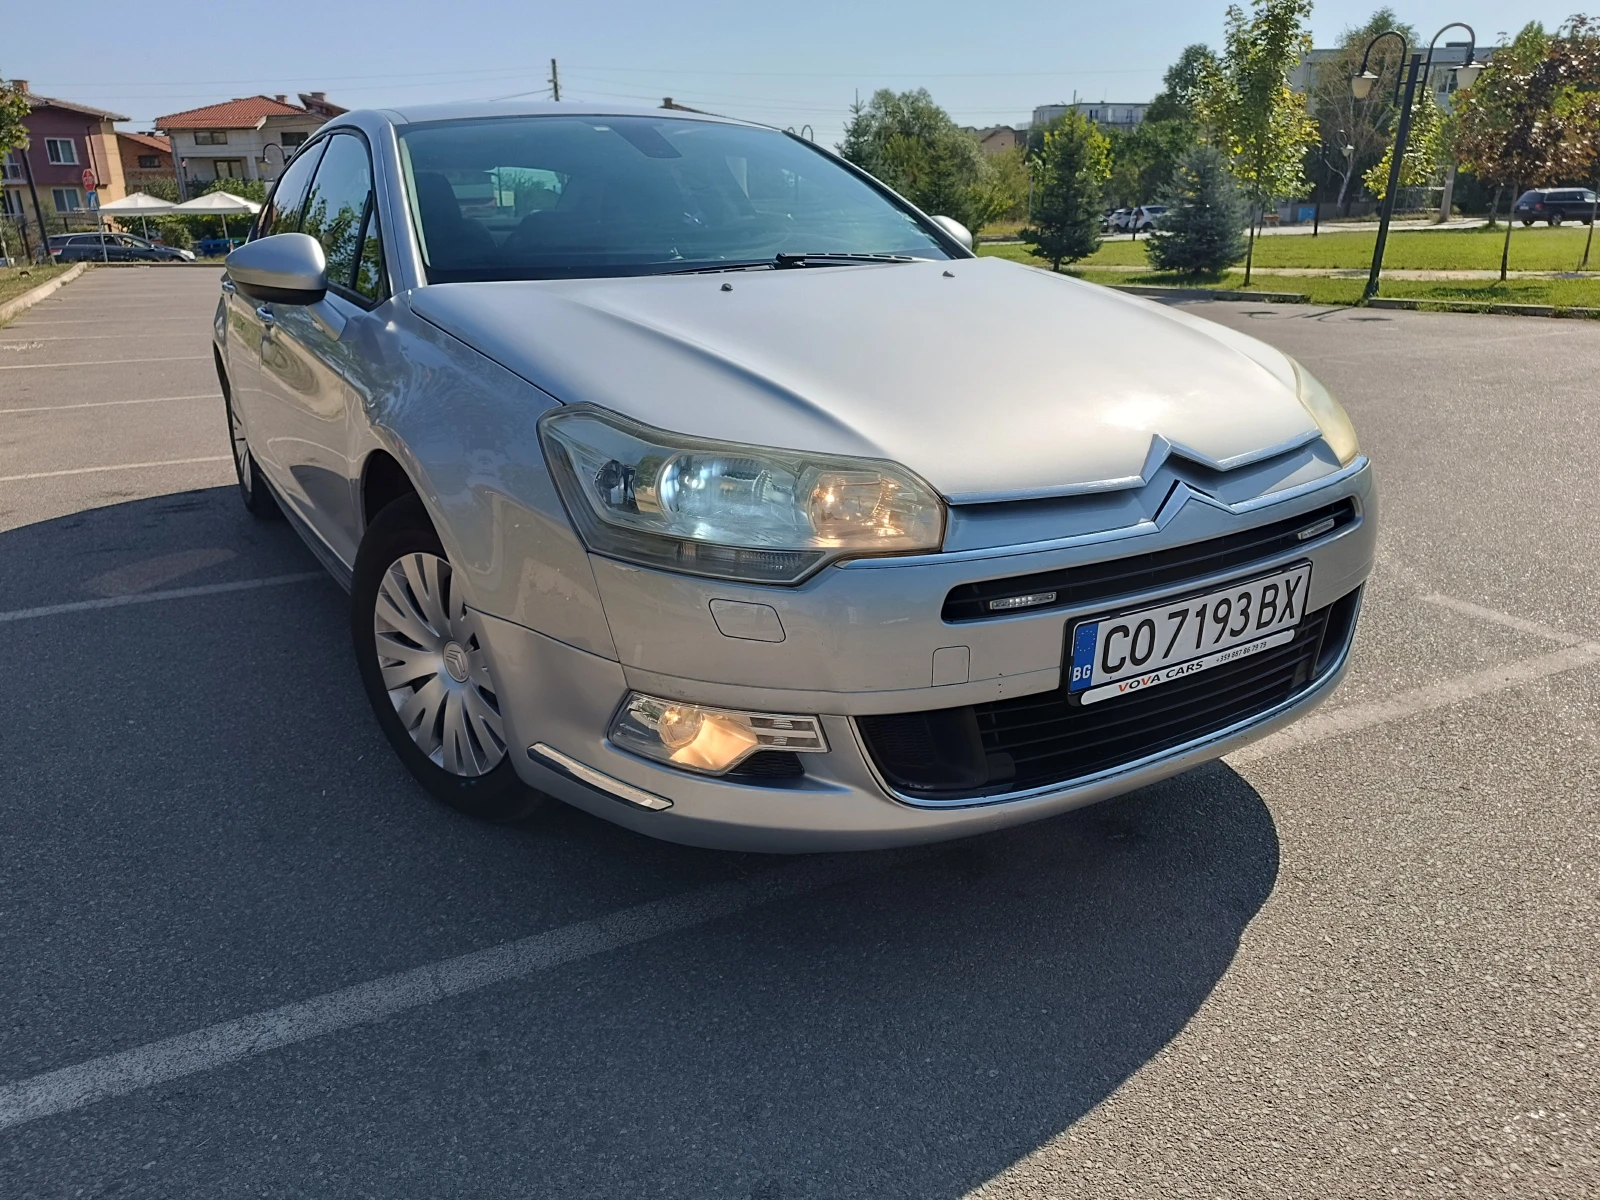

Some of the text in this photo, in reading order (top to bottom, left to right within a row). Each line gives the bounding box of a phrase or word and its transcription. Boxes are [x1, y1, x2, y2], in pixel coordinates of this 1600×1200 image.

[1072, 665, 1091, 682] BG
[1118, 674, 1161, 692] VOVA
[1165, 660, 1203, 679] CARS
